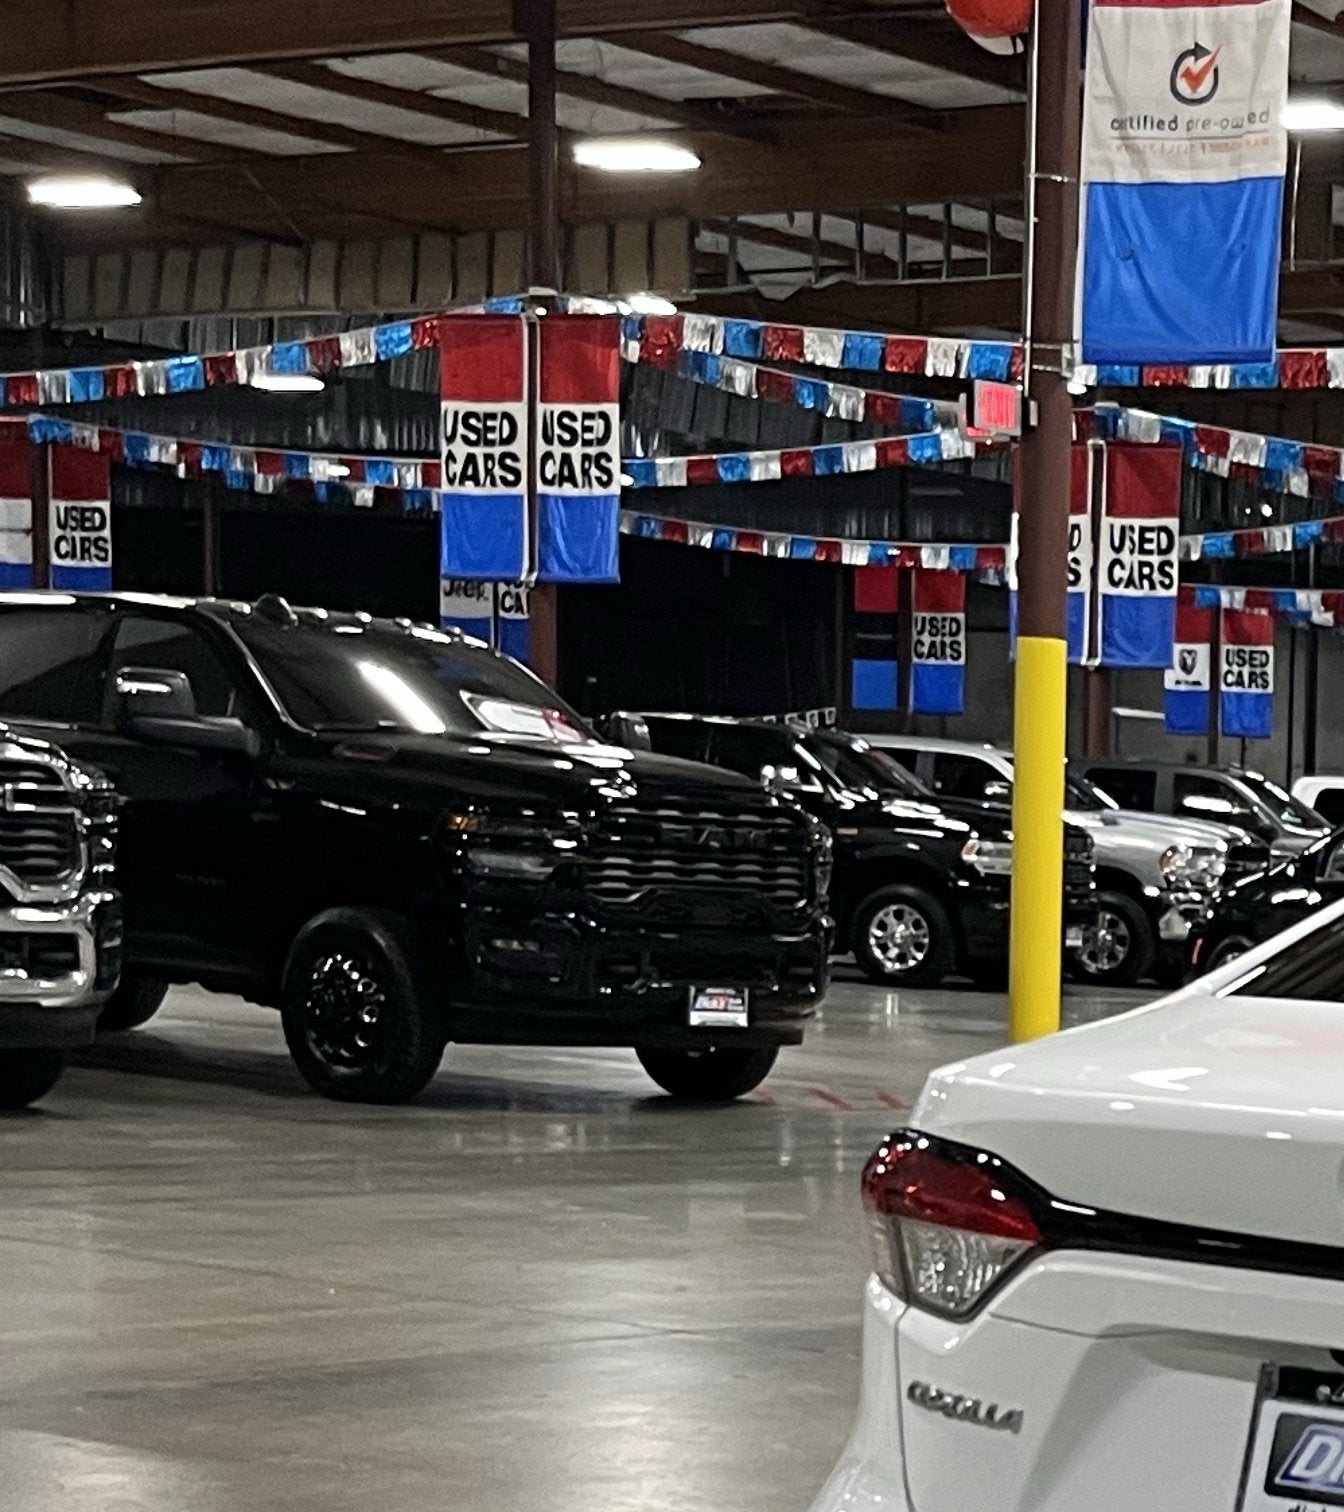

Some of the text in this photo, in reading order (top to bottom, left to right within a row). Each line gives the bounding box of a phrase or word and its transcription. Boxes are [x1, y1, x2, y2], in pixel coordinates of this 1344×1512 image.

[444, 409, 518, 447] USED
[541, 410, 612, 447] USED
[444, 449, 521, 488] CARS
[539, 450, 613, 489] CARS
[56, 505, 107, 532] USED
[1110, 523, 1175, 556] USED
[1108, 558, 1174, 590] CARS
[915, 616, 961, 637] USED
[1225, 649, 1269, 668] USED
[1223, 670, 1270, 689] CARS
